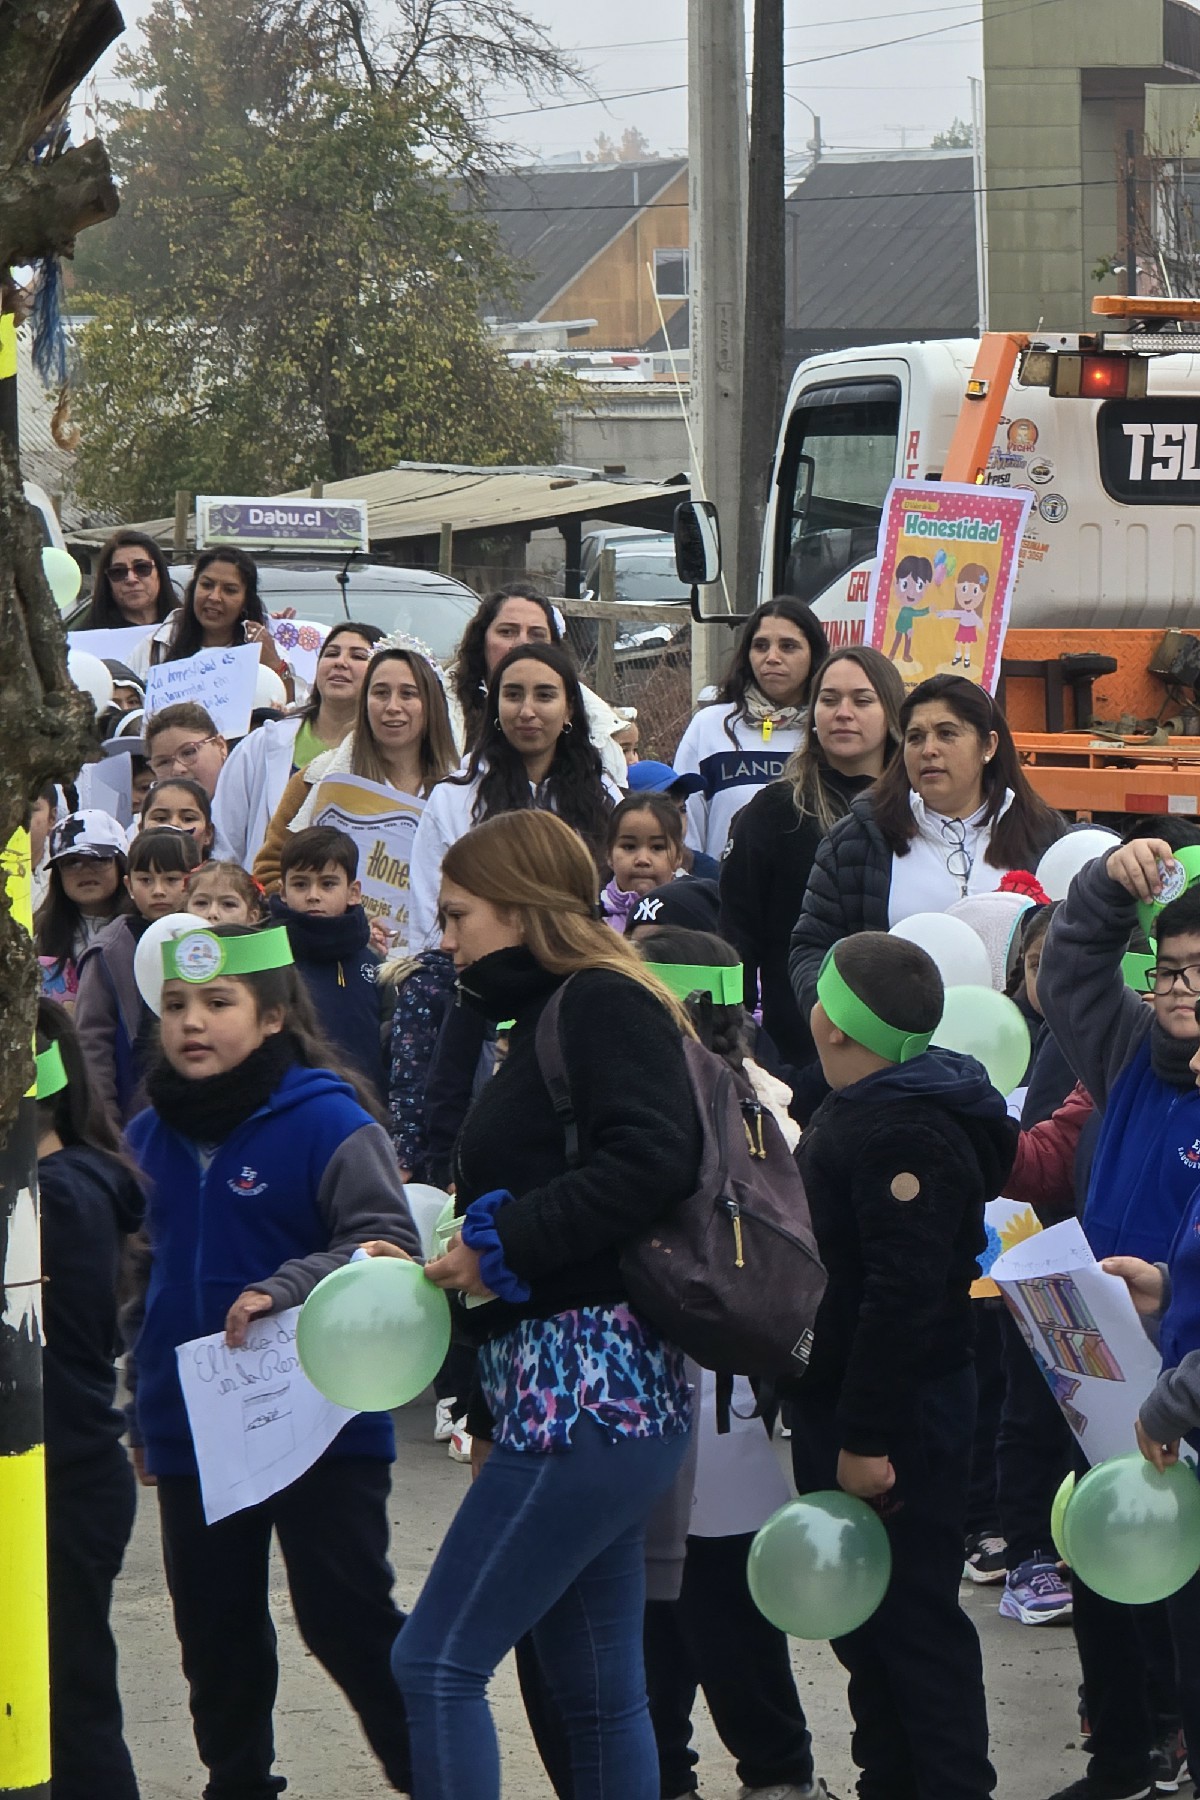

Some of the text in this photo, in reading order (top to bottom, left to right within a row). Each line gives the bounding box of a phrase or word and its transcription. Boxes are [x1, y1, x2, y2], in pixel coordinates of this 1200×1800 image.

[249, 508, 321, 527] Dabu.cl
[904, 514, 1001, 542] Honestidad
[721, 760, 784, 781] LAND
[367, 840, 411, 890] Hone
